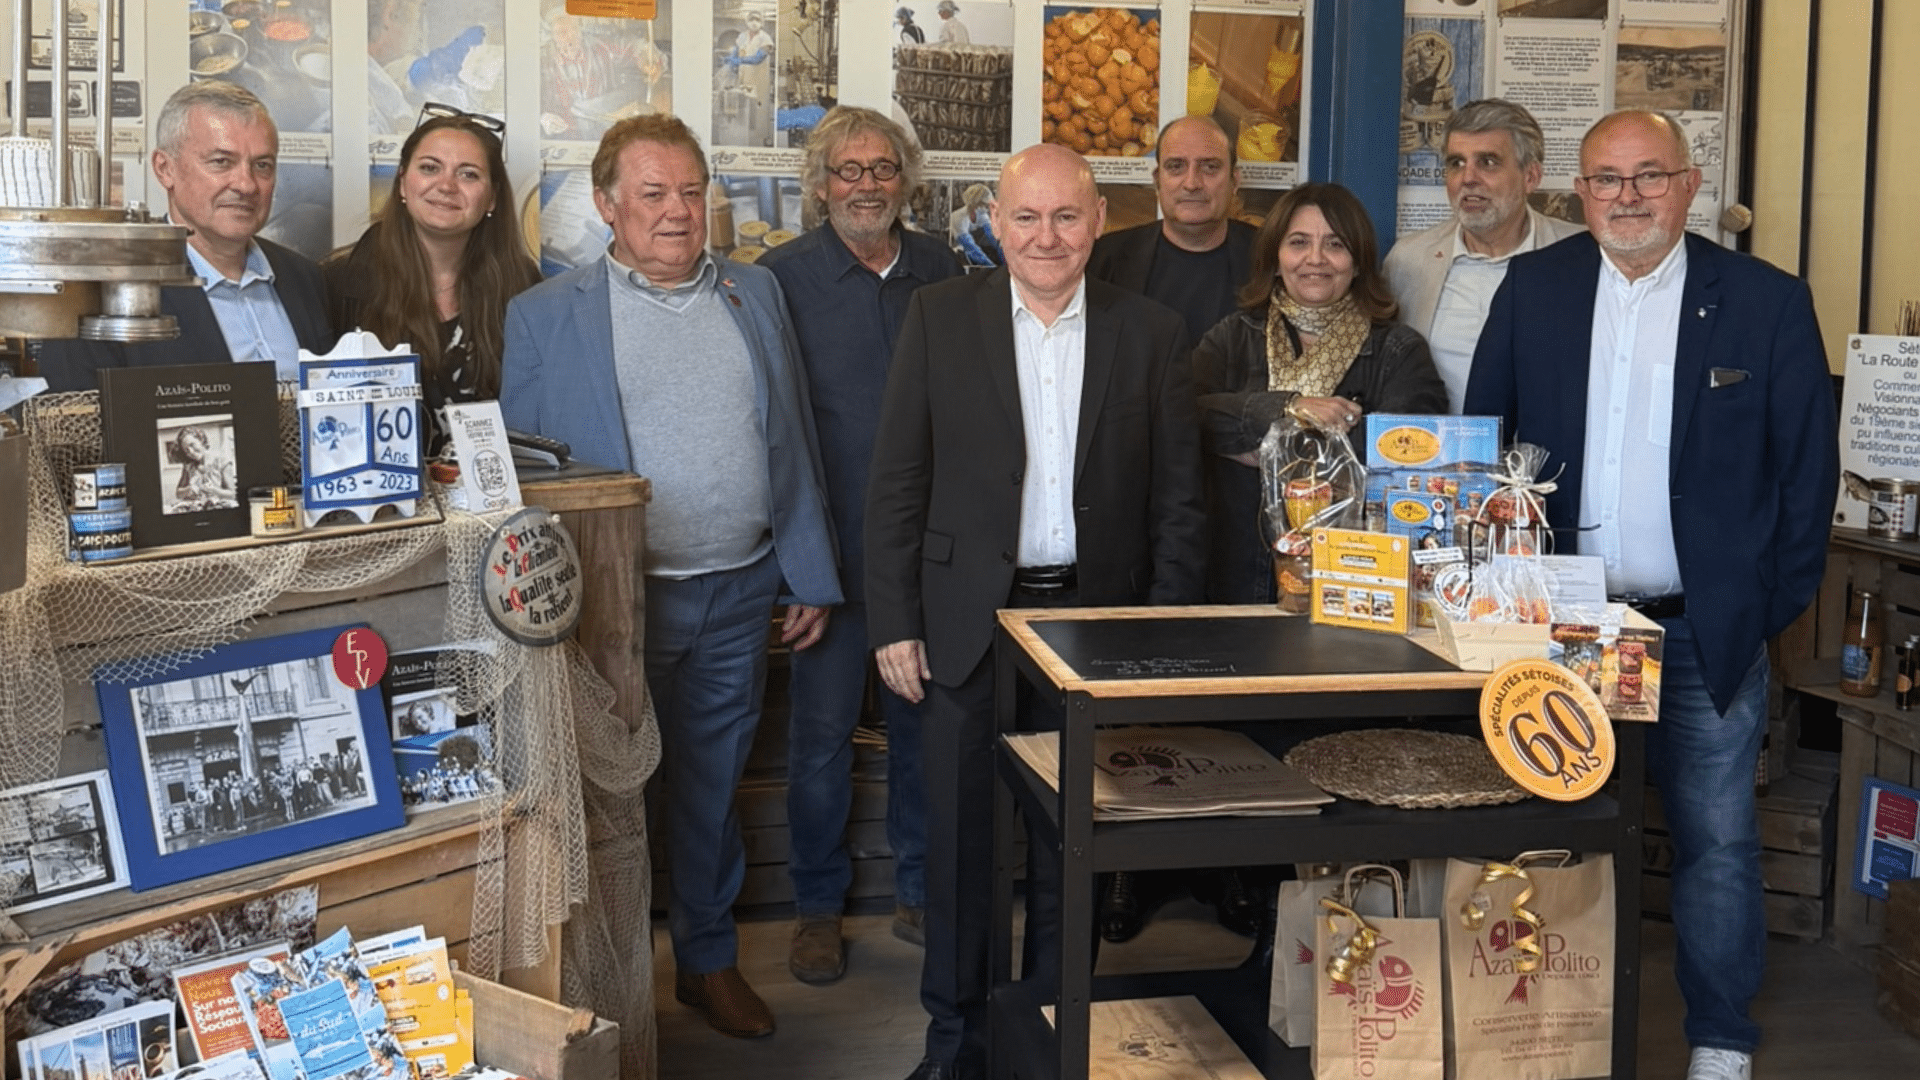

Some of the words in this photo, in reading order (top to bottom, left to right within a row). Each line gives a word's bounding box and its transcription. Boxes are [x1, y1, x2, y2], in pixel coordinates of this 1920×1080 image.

[1880, 354, 1919, 368] Route
[326, 367, 395, 380] Anniversaire
[1903, 371, 1917, 380] ou
[315, 390, 365, 403] SAINT
[1857, 403, 1919, 419] Négociants
[376, 406, 413, 443] 60
[1850, 415, 1865, 425] du
[1857, 428, 1872, 439] pu
[1850, 439, 1901, 453] traditions
[380, 446, 409, 464] Ans
[315, 476, 358, 499] 1963
[379, 473, 413, 491] 2023
[483, 498, 510, 510] Google
[529, 605, 541, 624] la
[1491, 671, 1522, 738] SPÉCIALITÉS
[1521, 668, 1575, 692] SÉTOISES
[1511, 684, 1541, 709] DEPUIS
[1508, 690, 1597, 778] 60
[1560, 751, 1602, 789] ANS
[1472, 1012, 1539, 1026] Conserverie
